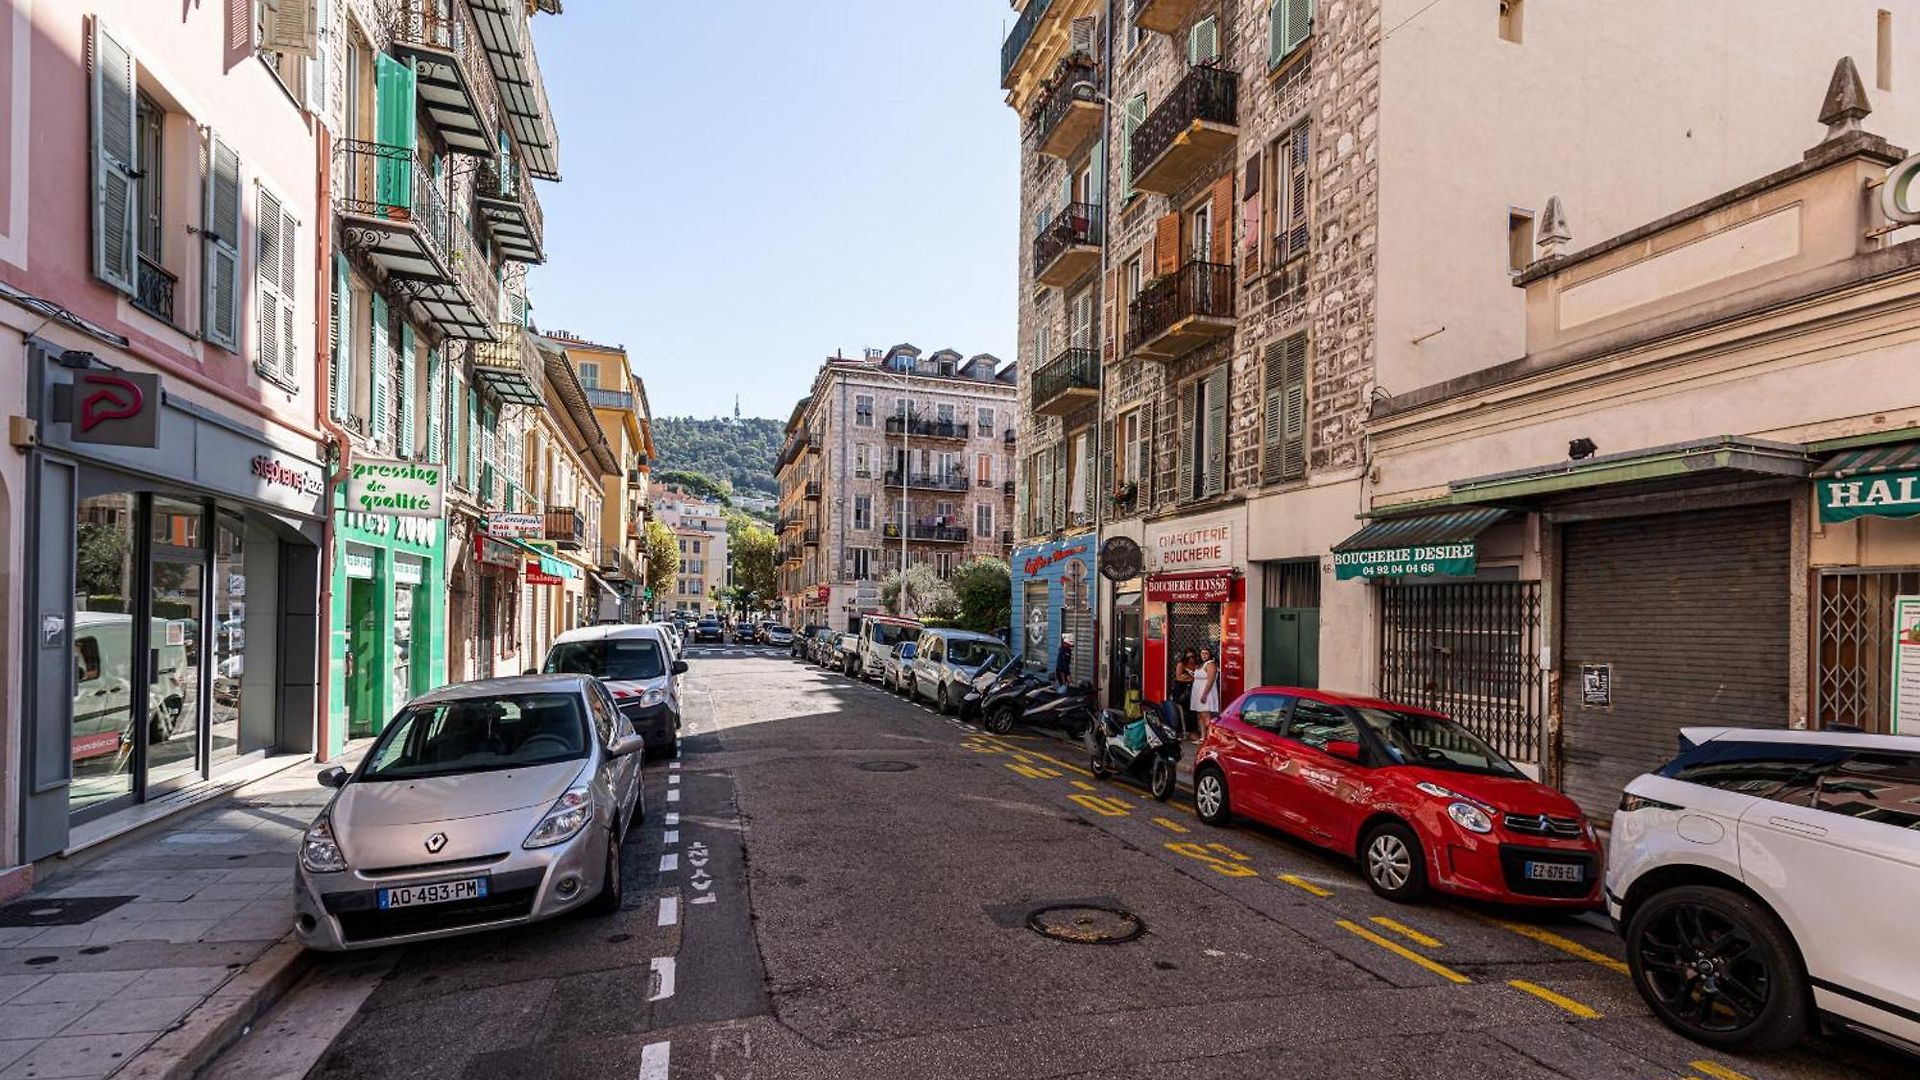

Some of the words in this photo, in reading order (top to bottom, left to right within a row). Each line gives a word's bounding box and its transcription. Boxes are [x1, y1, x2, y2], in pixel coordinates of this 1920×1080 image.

[353, 464, 438, 485] pressing
[367, 481, 386, 492] de
[360, 493, 431, 511] qualité
[1159, 527, 1228, 548] CHARCUTERIE
[1164, 545, 1221, 564] BOUCHERIE
[1335, 548, 1411, 565] BOUCHERIE
[1414, 544, 1474, 561] DESIRE
[1363, 565, 1374, 575] 04
[1377, 564, 1389, 574] 92
[1391, 564, 1402, 574] 04
[1406, 563, 1418, 573] 04
[1421, 562, 1435, 572] 66
[1148, 579, 1194, 592] BOUCHERIE
[1194, 576, 1227, 592] ULYSSE
